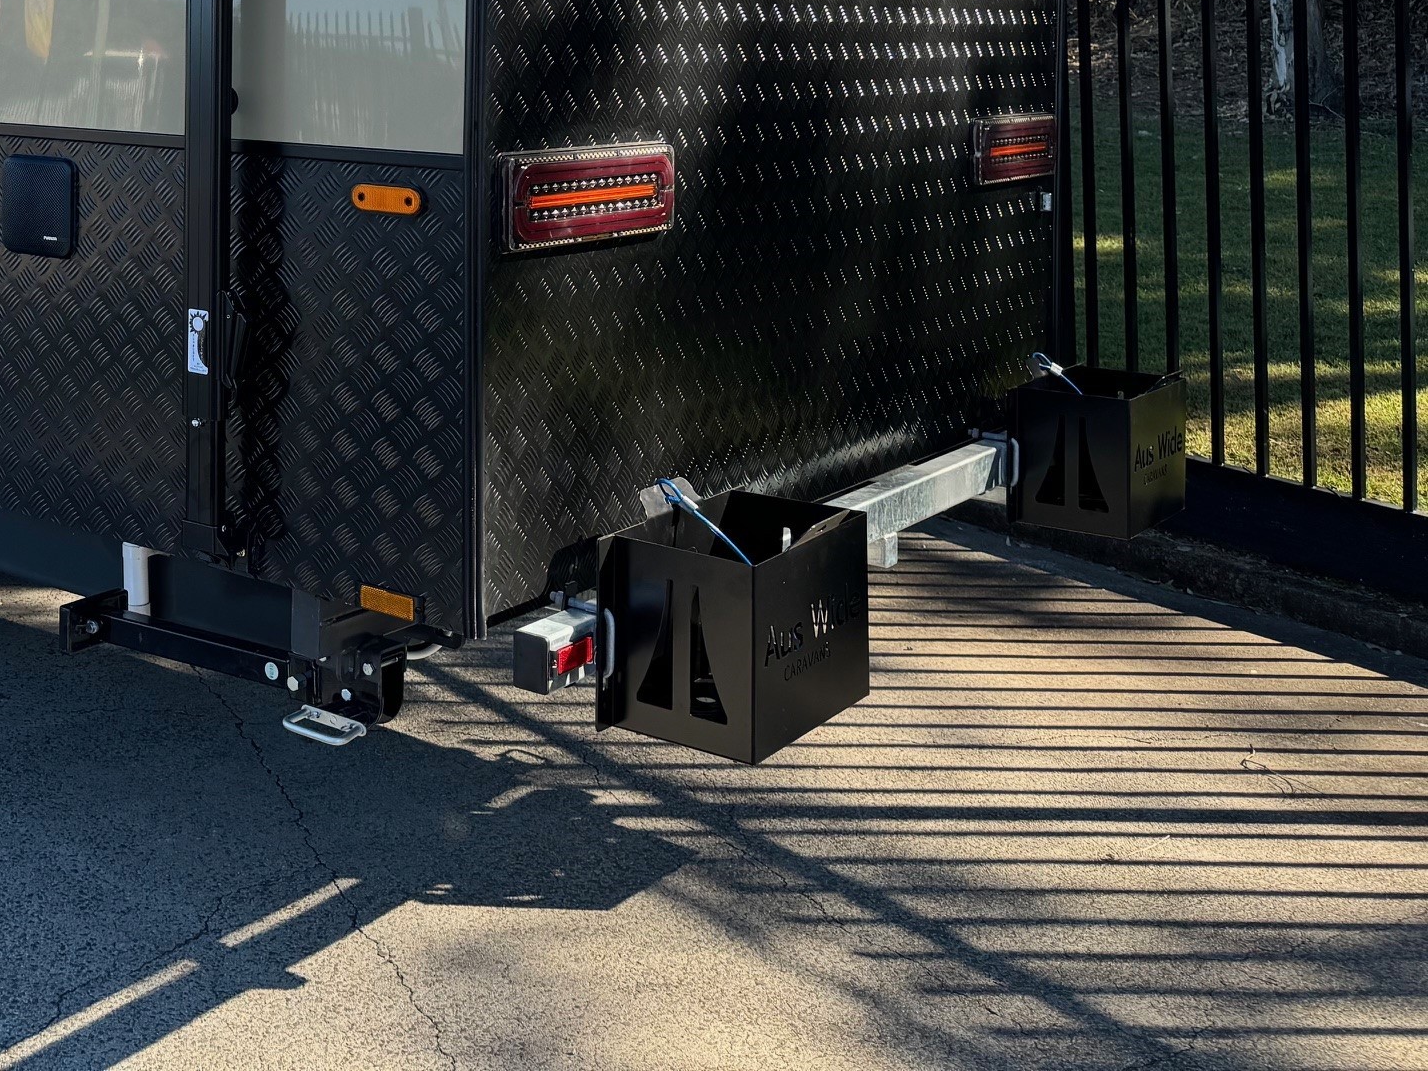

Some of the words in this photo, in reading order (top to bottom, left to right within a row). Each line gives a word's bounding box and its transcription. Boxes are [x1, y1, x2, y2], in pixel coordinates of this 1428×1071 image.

[1134, 443, 1154, 473] Aus
[1157, 425, 1183, 460] Wide
[764, 621, 803, 667] Aus
[810, 581, 861, 639] Wide
[783, 641, 832, 682] CARAVANS
